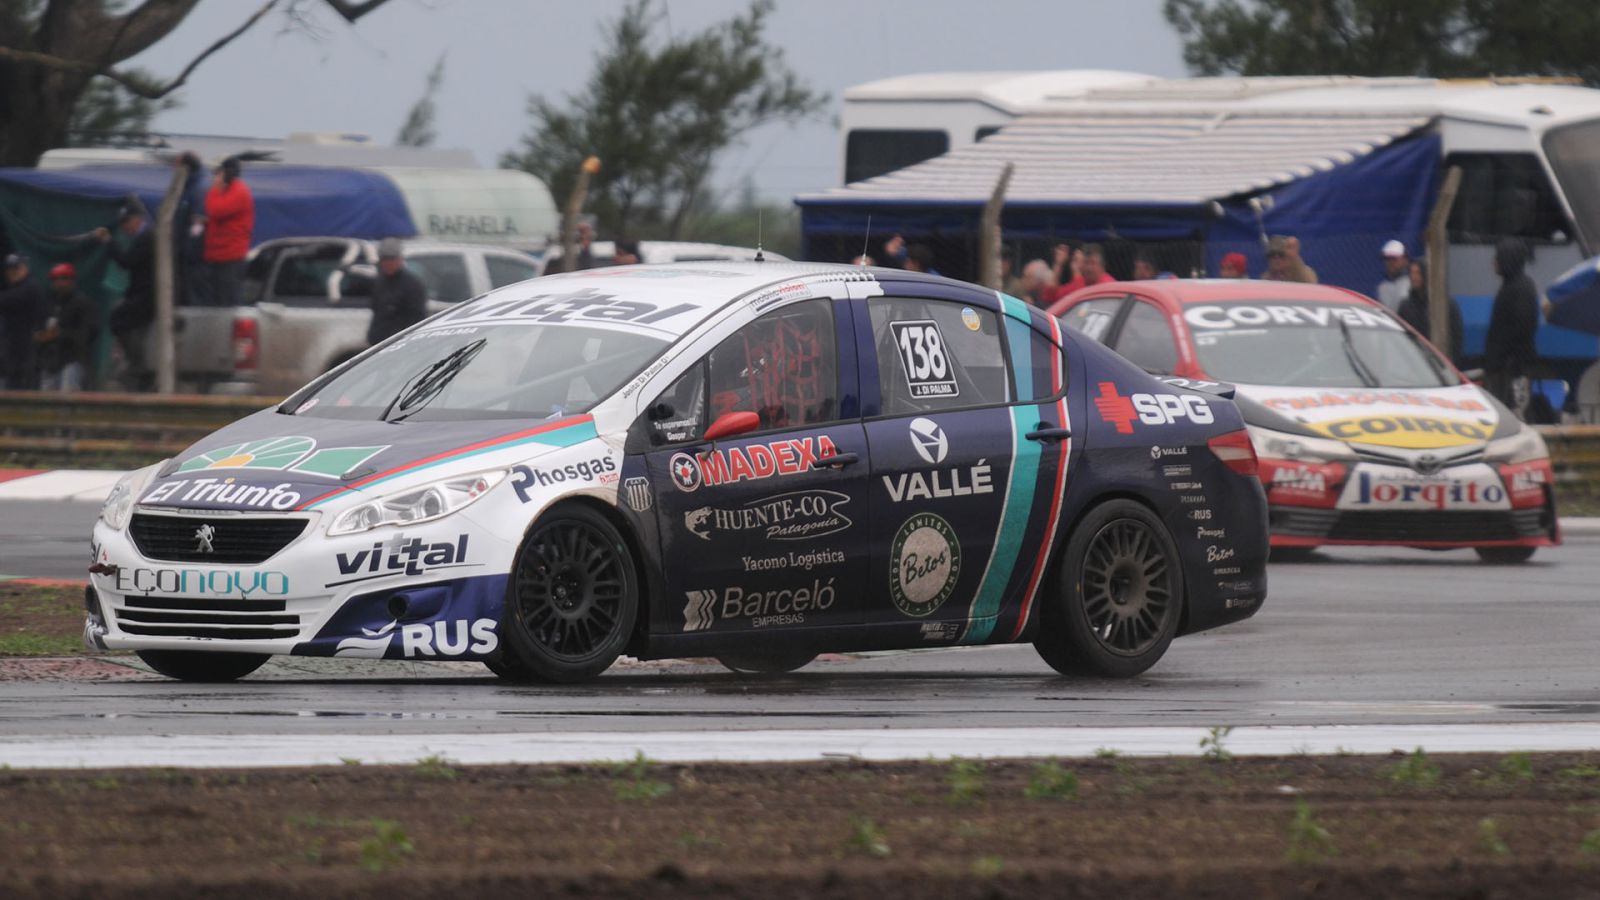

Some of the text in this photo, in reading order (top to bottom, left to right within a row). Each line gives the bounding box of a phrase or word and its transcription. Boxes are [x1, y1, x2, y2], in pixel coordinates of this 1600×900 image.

[429, 215, 518, 235] RAFAELA
[1184, 305, 1405, 332] CORVEN
[900, 326, 947, 380] 138
[929, 384, 953, 395] PALMA
[1131, 393, 1215, 425] SPG
[1328, 416, 1487, 440] COIRO
[695, 434, 842, 488] MADEXA
[141, 477, 301, 510] El Triunfo
[511, 455, 616, 504] Phosgas
[883, 458, 994, 503] VALLÉ
[714, 496, 827, 530] HUENTE-CO
[766, 517, 840, 538] Patagonia
[1194, 509, 1212, 520] RUS
[336, 532, 469, 576] vittal
[742, 548, 846, 571] Yacono Logística
[903, 551, 946, 585] Betos
[721, 577, 836, 619] Barceló
[753, 613, 805, 628] EMPRESAS
[402, 618, 499, 657] RUS
